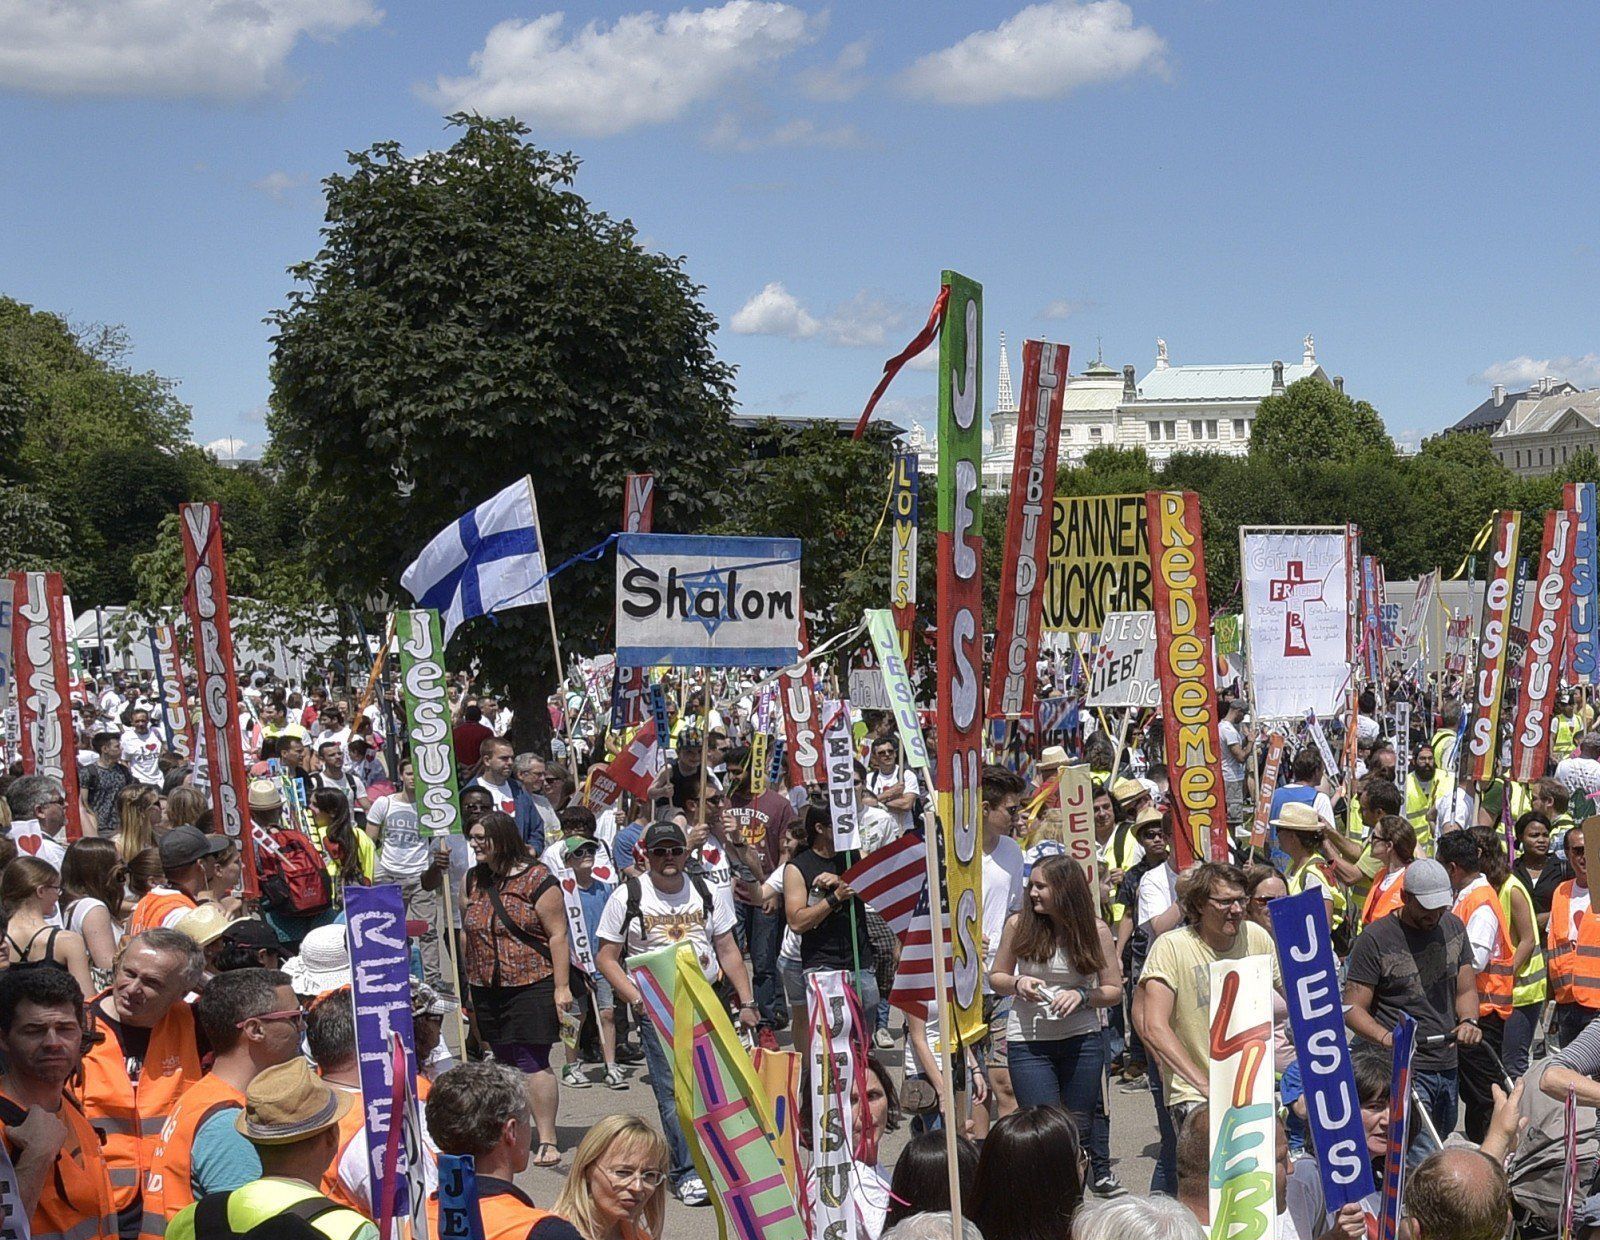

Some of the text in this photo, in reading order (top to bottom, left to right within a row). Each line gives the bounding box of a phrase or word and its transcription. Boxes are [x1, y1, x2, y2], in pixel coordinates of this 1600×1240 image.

[621, 566, 795, 621] Shalom
[895, 459, 913, 609] LOVES
[1573, 486, 1598, 675] JESUS
[153, 627, 191, 758] JESUS
[880, 628, 927, 758] JESUS
[950, 299, 979, 1010] JESUS
[1001, 555, 1037, 714] DICH
[1090, 649, 1143, 698] LIEBT
[752, 736, 766, 791] JESUS
[826, 711, 855, 835] JESUS
[568, 905, 594, 973] DICH
[1290, 914, 1363, 1185] JESUS
